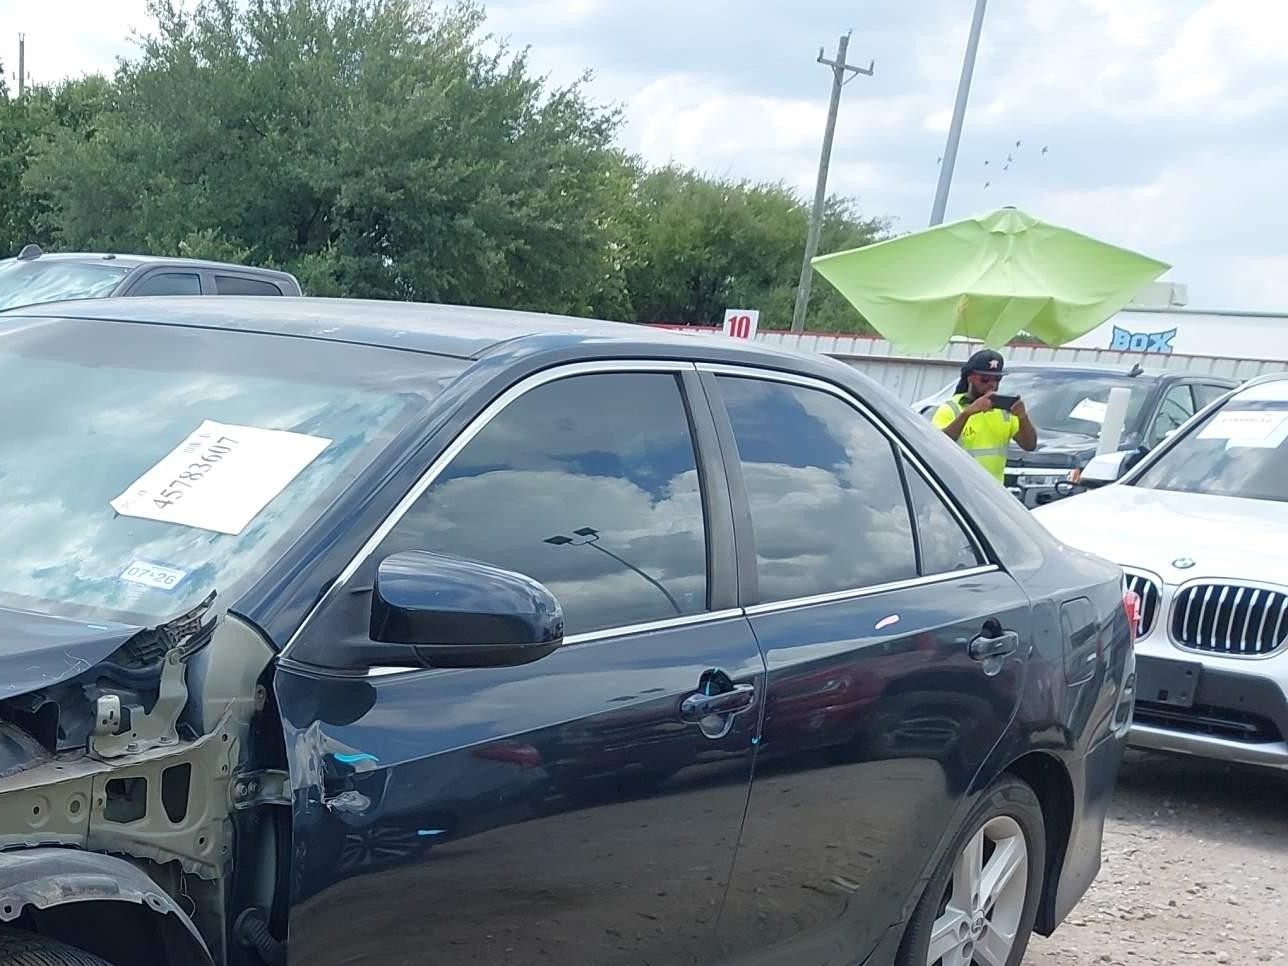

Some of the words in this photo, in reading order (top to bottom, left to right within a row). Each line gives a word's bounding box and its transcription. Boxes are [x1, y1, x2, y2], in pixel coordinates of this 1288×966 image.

[728, 316, 751, 338] 10
[1110, 325, 1178, 353] BOX
[153, 436, 240, 510] 45783607
